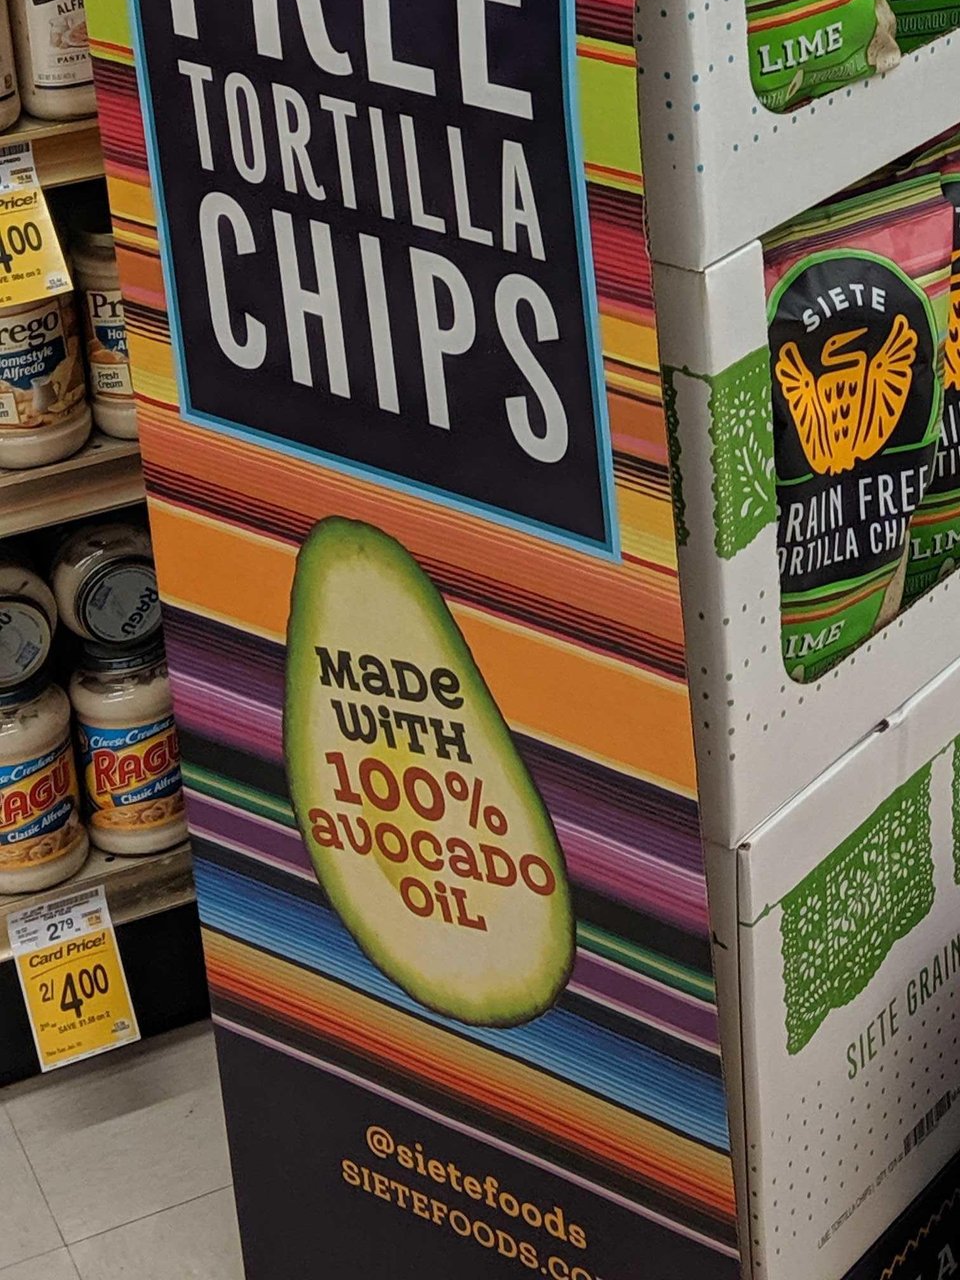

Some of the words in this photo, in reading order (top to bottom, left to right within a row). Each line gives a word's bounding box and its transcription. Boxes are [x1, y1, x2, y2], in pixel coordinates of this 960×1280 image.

[57, 52, 87, 65] PASTA
[758, 21, 844, 74] LIME
[178, 59, 547, 263] TORTILLA
[199, 191, 570, 464] CHIPS
[803, 283, 888, 333] SIETE
[0, 311, 60, 349] rego
[0, 345, 54, 369] omestyle
[2, 361, 46, 382] Alfredo
[98, 371, 120, 381] Fresh
[97, 380, 124, 390] Cream
[783, 484, 844, 544] RAIN
[870, 516, 912, 555] CHI
[785, 620, 845, 659] IME
[90, 735, 126, 749] Cheese
[0, 754, 72, 828] AGÚ
[120, 788, 153, 806] Classic
[325, 751, 508, 837] 100%
[7, 823, 40, 843] Classic
[46, 917, 74, 942] 279
[29, 947, 64, 968] Card
[67, 932, 107, 957] Price!
[60, 963, 110, 1019] 400
[58, 1021, 77, 1034] SAVE
[846, 997, 900, 1081] SIETE
[366, 1125, 587, 1250] @sietefoods
[341, 1158, 604, 1280] SIETEFOODS.CO
